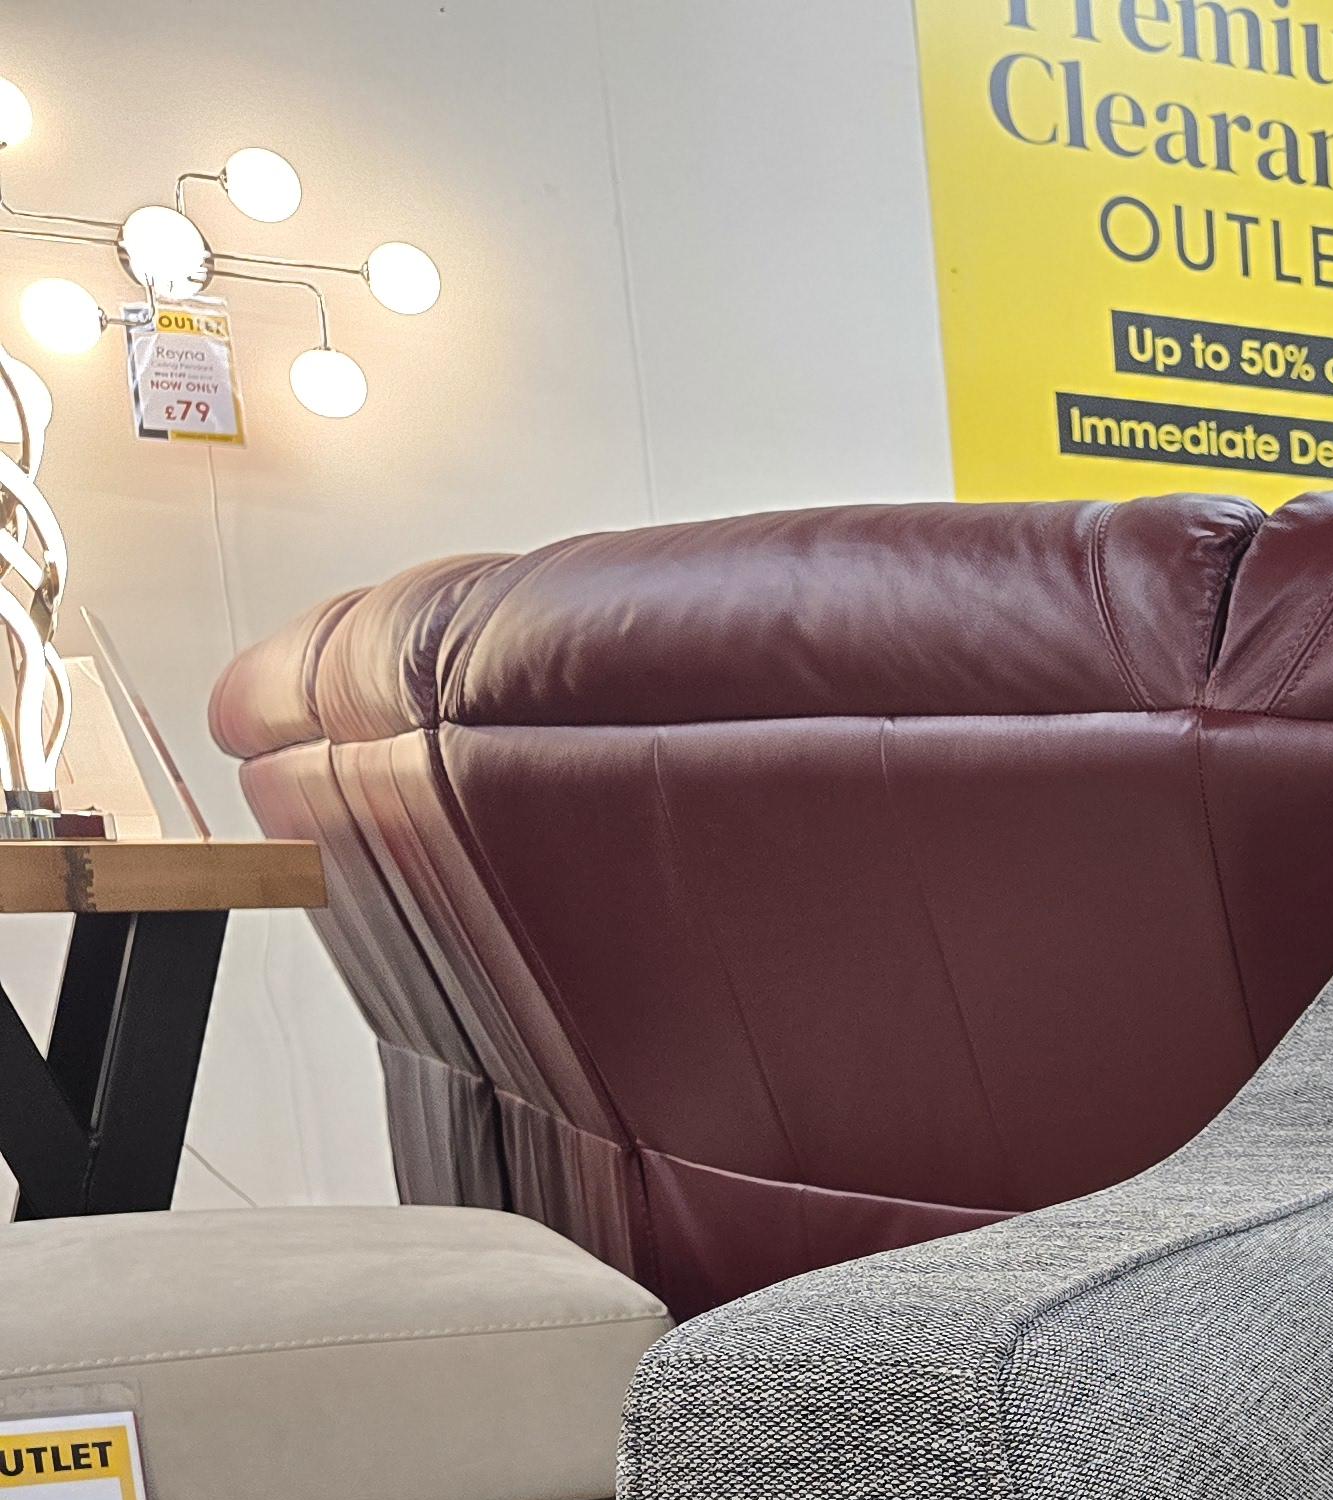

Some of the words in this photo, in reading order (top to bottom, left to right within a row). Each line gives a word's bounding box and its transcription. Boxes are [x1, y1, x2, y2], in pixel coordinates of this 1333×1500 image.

[156, 346, 205, 362] Reyna
[1127, 325, 1182, 372] Up
[1191, 334, 1231, 372] to
[1239, 340, 1315, 382] 50%
[150, 380, 182, 391] NOW
[185, 382, 219, 394] ONLY
[165, 400, 210, 422] £79
[1069, 406, 1279, 463] Immediate
